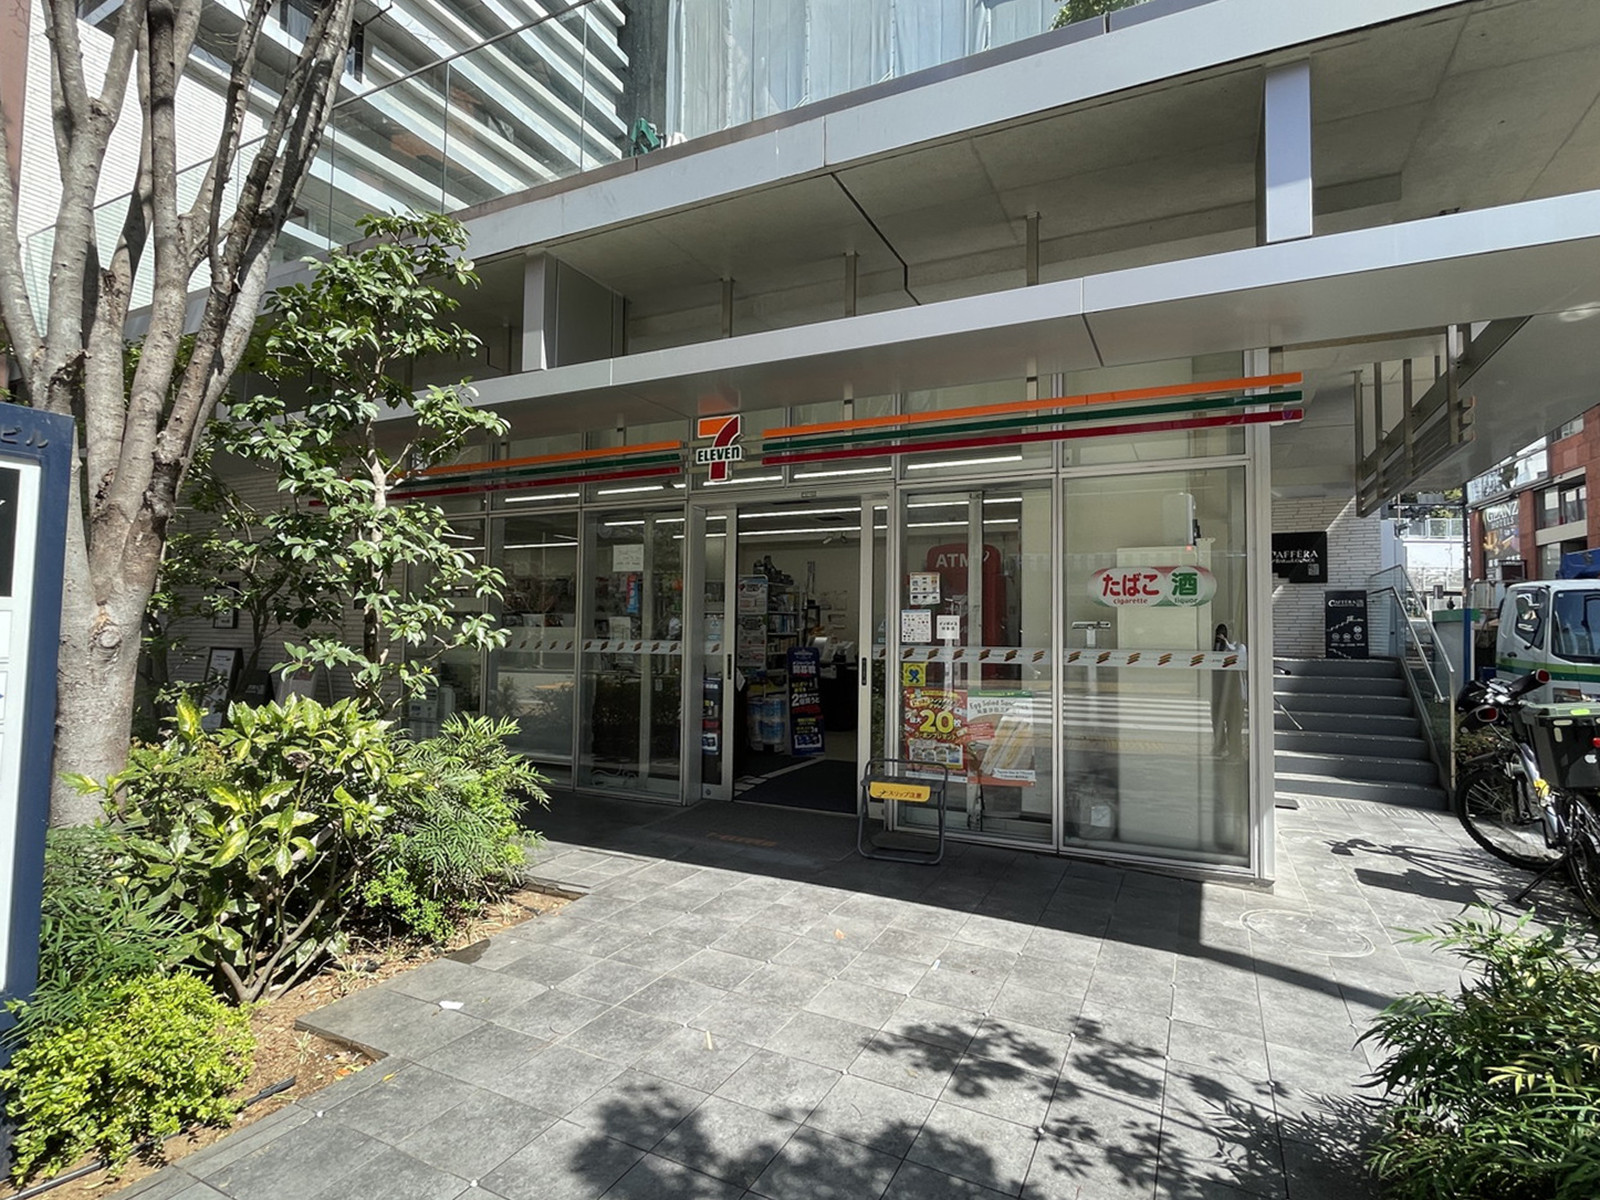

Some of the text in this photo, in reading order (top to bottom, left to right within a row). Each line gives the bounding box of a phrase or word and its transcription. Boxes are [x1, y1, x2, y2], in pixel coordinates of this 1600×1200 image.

[1102, 572, 1160, 597] たばこ
[1171, 572, 1198, 596] 酒
